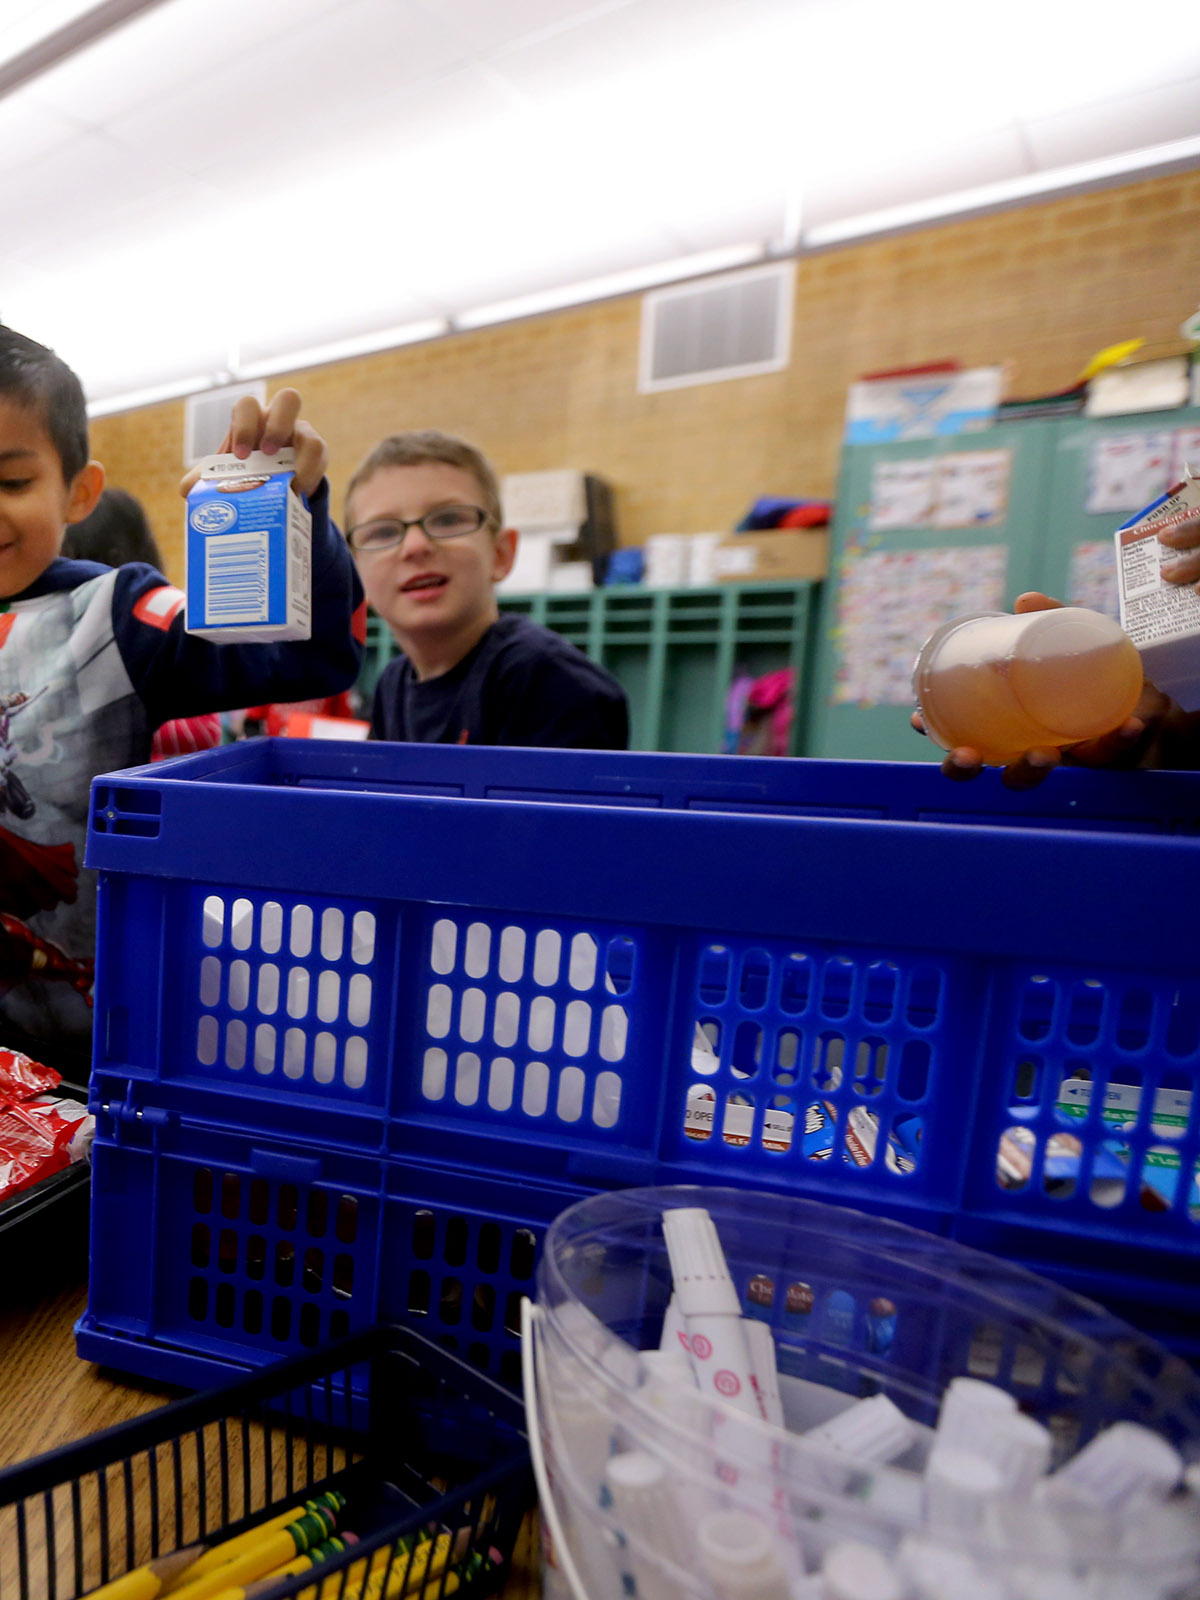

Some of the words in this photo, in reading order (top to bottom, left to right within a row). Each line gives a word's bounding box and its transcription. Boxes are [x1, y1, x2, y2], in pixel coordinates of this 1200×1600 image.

[1147, 505, 1169, 522] PUSH
[1169, 496, 1180, 506] UP
[694, 1111, 713, 1122] OPE
